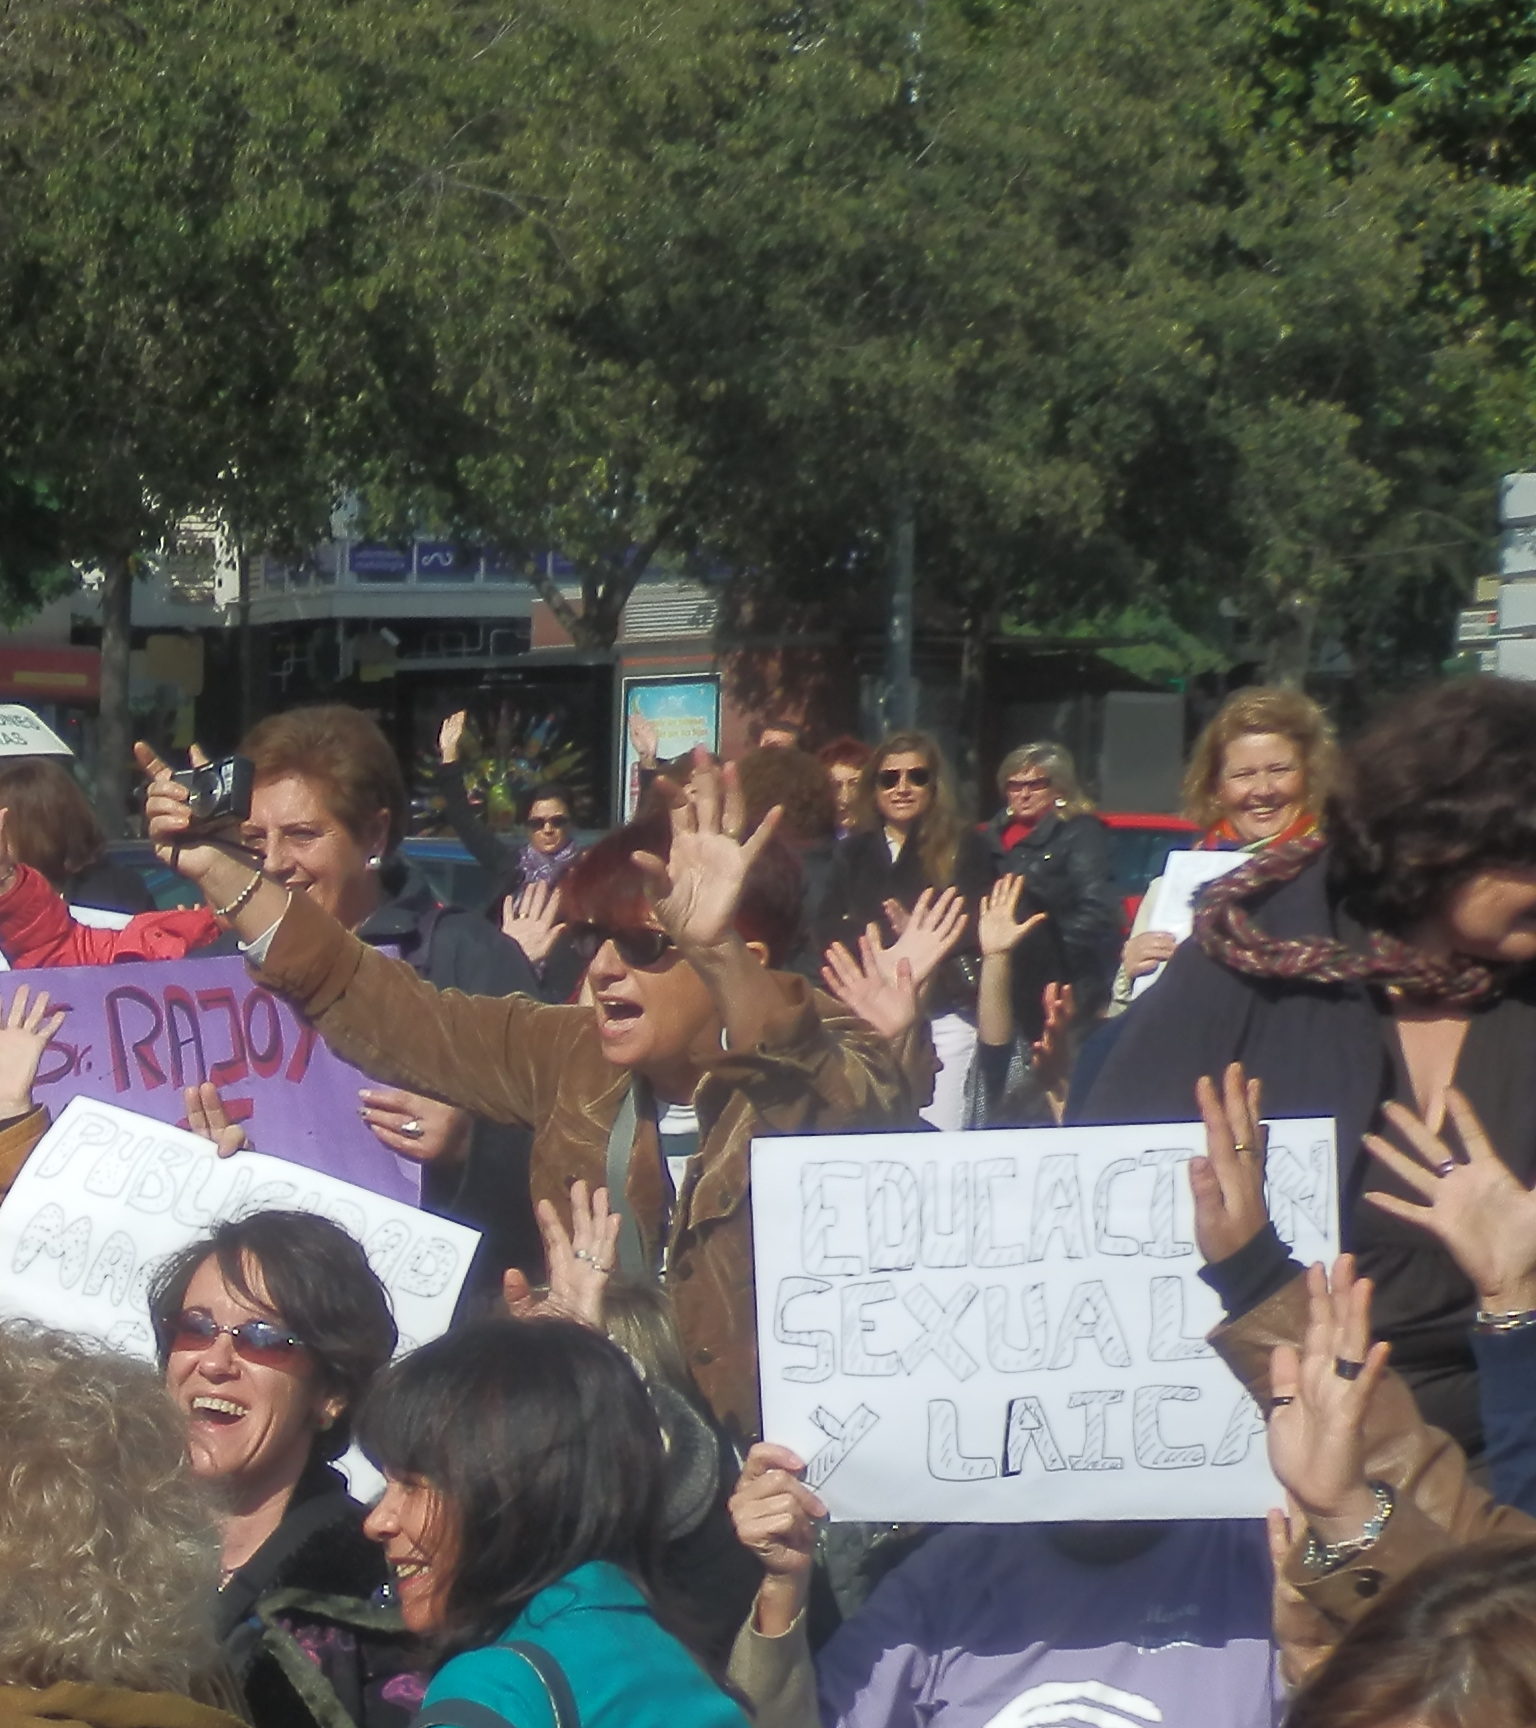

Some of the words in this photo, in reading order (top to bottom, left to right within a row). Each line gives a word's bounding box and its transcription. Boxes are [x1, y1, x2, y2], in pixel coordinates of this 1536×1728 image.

[800, 1139, 1329, 1277] EDUCACIN
[773, 1275, 1218, 1383] SEXUAL
[805, 1402, 880, 1490] Y
